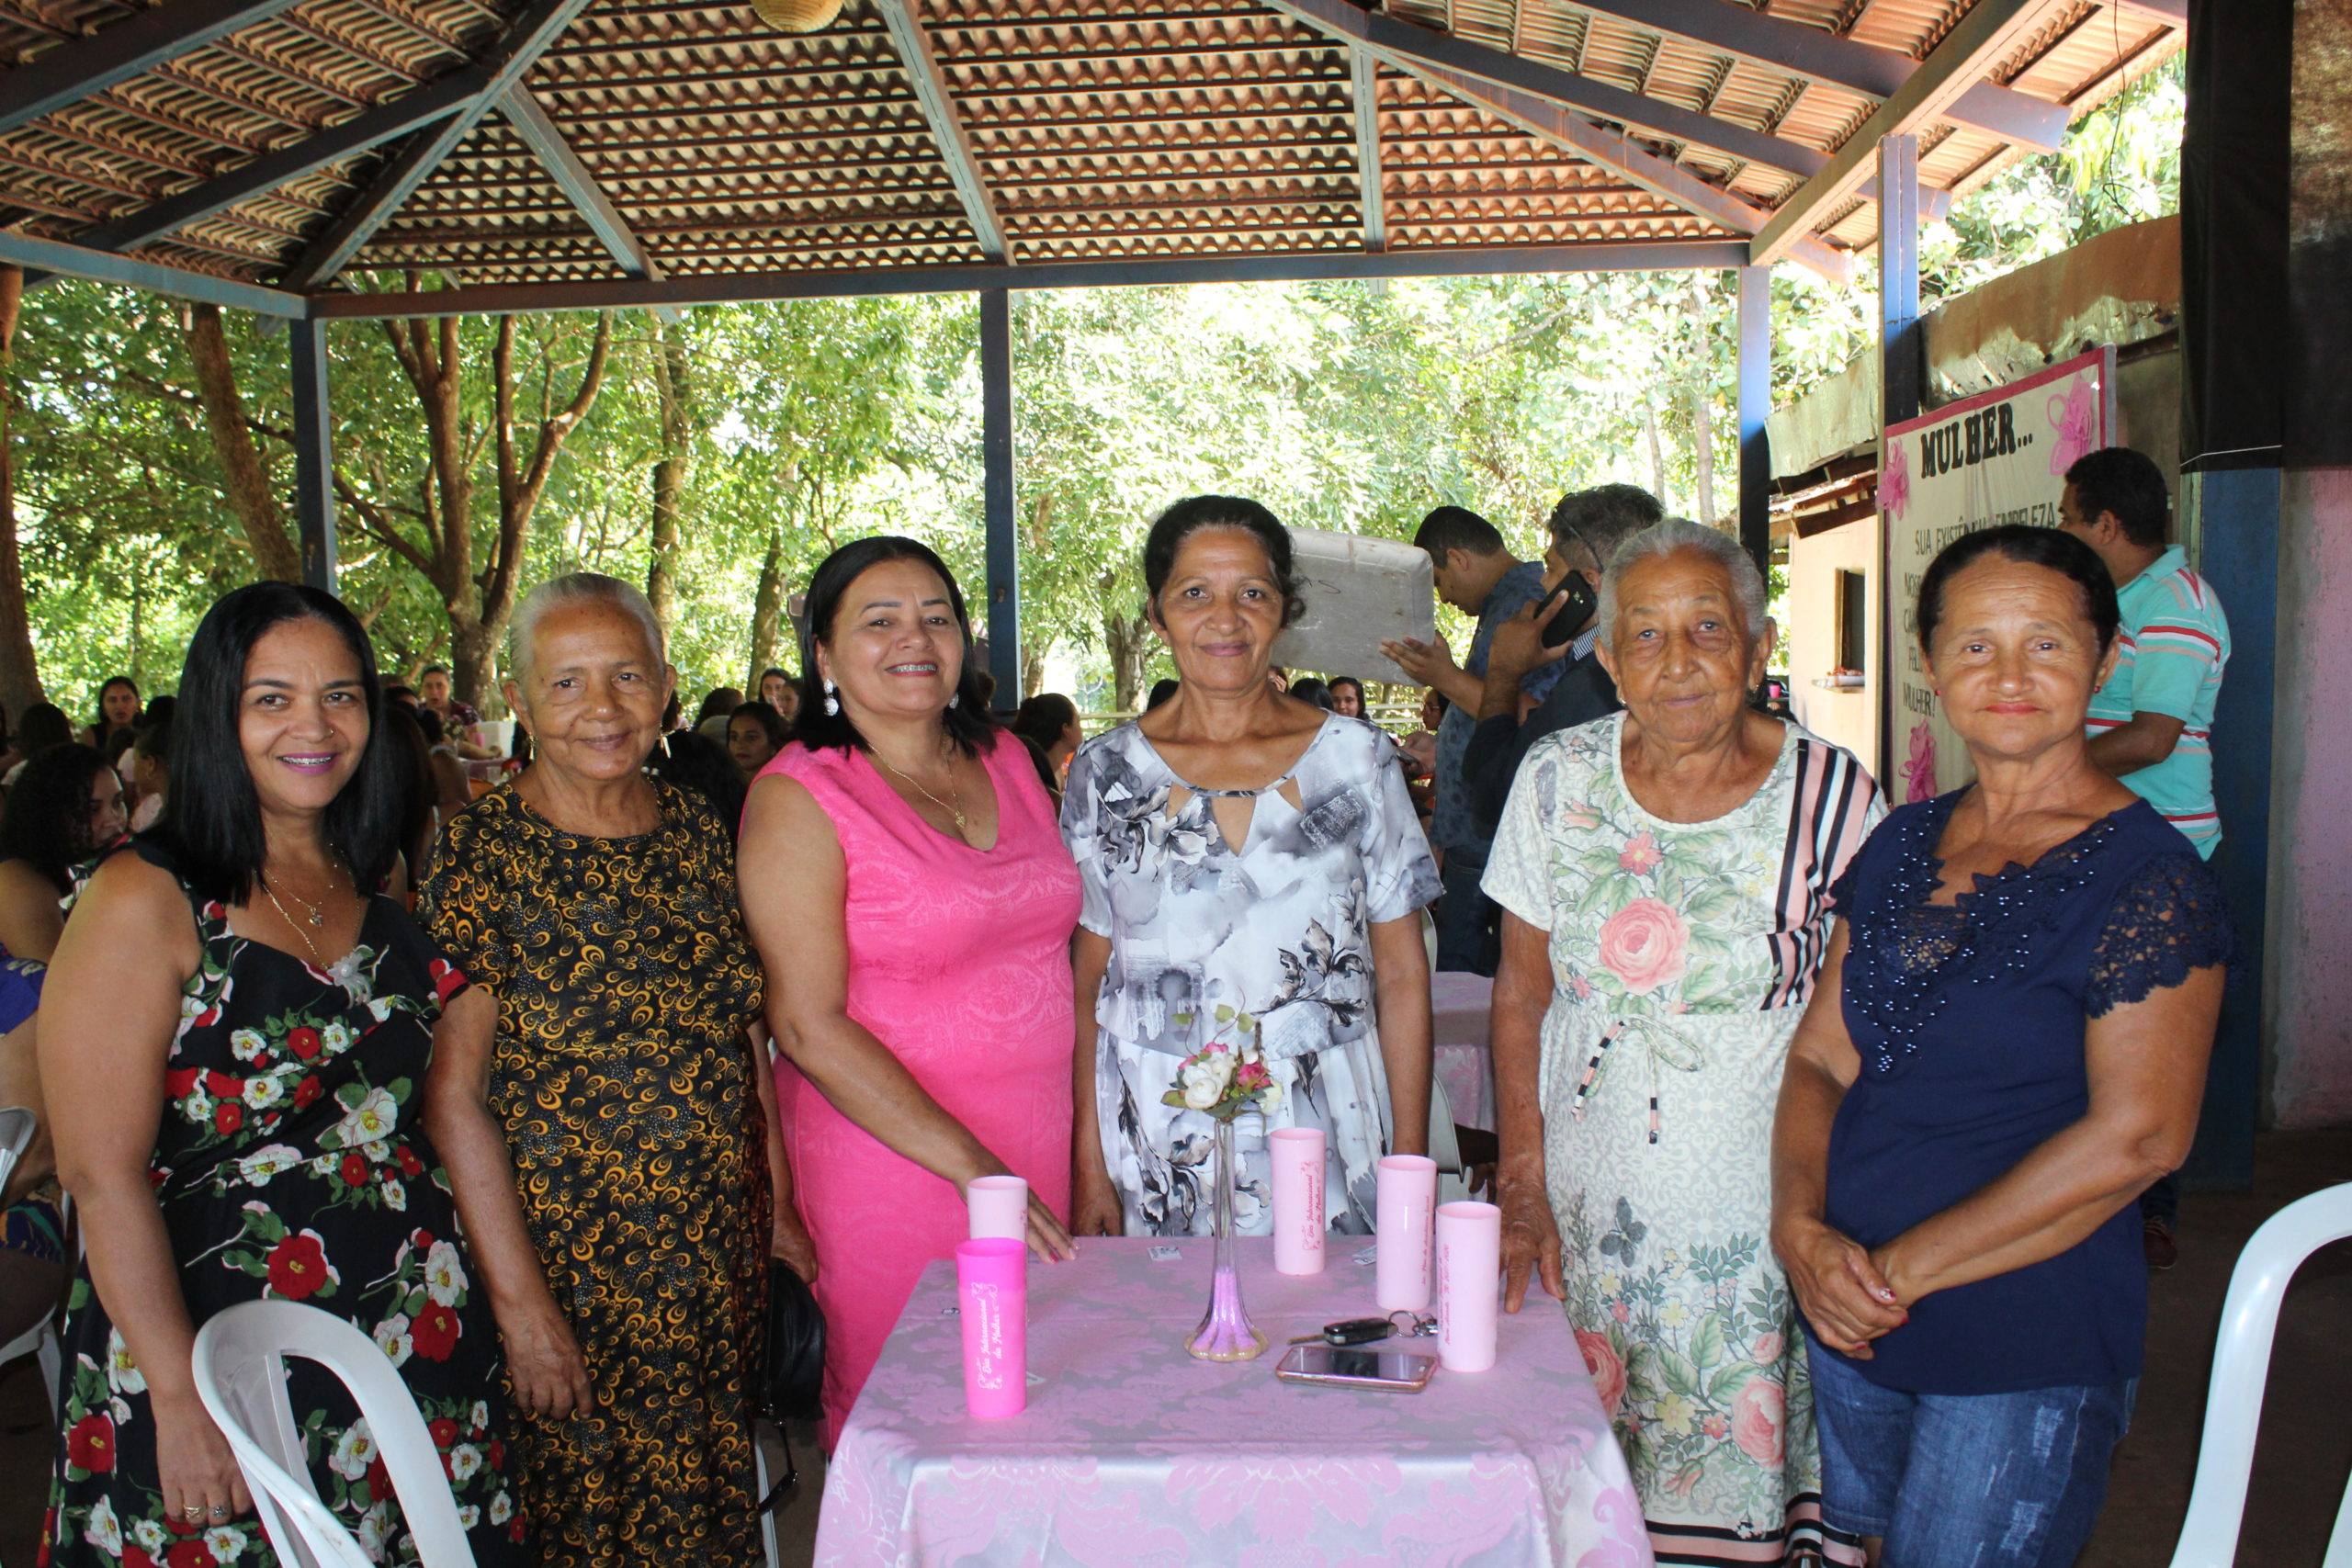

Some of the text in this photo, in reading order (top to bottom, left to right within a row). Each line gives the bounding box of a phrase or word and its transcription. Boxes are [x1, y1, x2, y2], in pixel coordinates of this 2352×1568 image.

[1920, 402, 2033, 479] MULHER...
[1915, 527, 1931, 555] SUA
[1903, 681, 1937, 717] MULHER!
[977, 1297, 992, 1374] Dia Internacional
[991, 1314, 1002, 1344] Mulher
